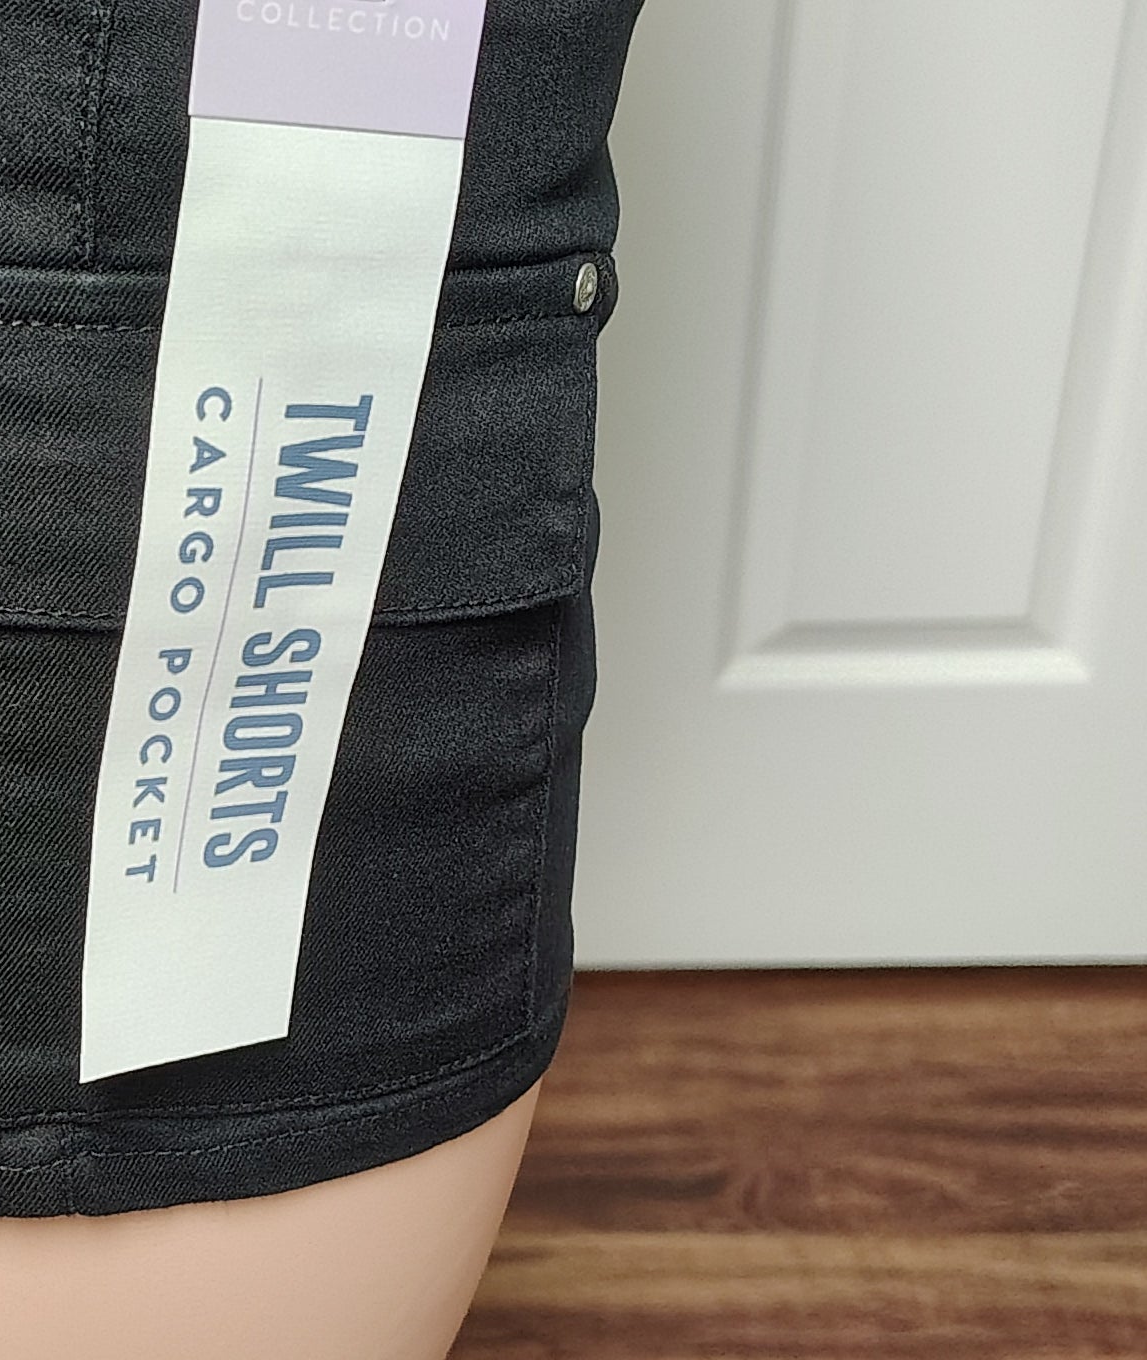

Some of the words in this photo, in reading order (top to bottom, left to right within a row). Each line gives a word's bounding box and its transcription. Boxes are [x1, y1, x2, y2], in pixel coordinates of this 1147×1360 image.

[237, 0, 450, 41] COLLECTION
[169, 386, 232, 614] CARGO
[253, 394, 373, 609] TWILL
[125, 648, 192, 882] POCKET
[203, 629, 322, 868] SHORTS
